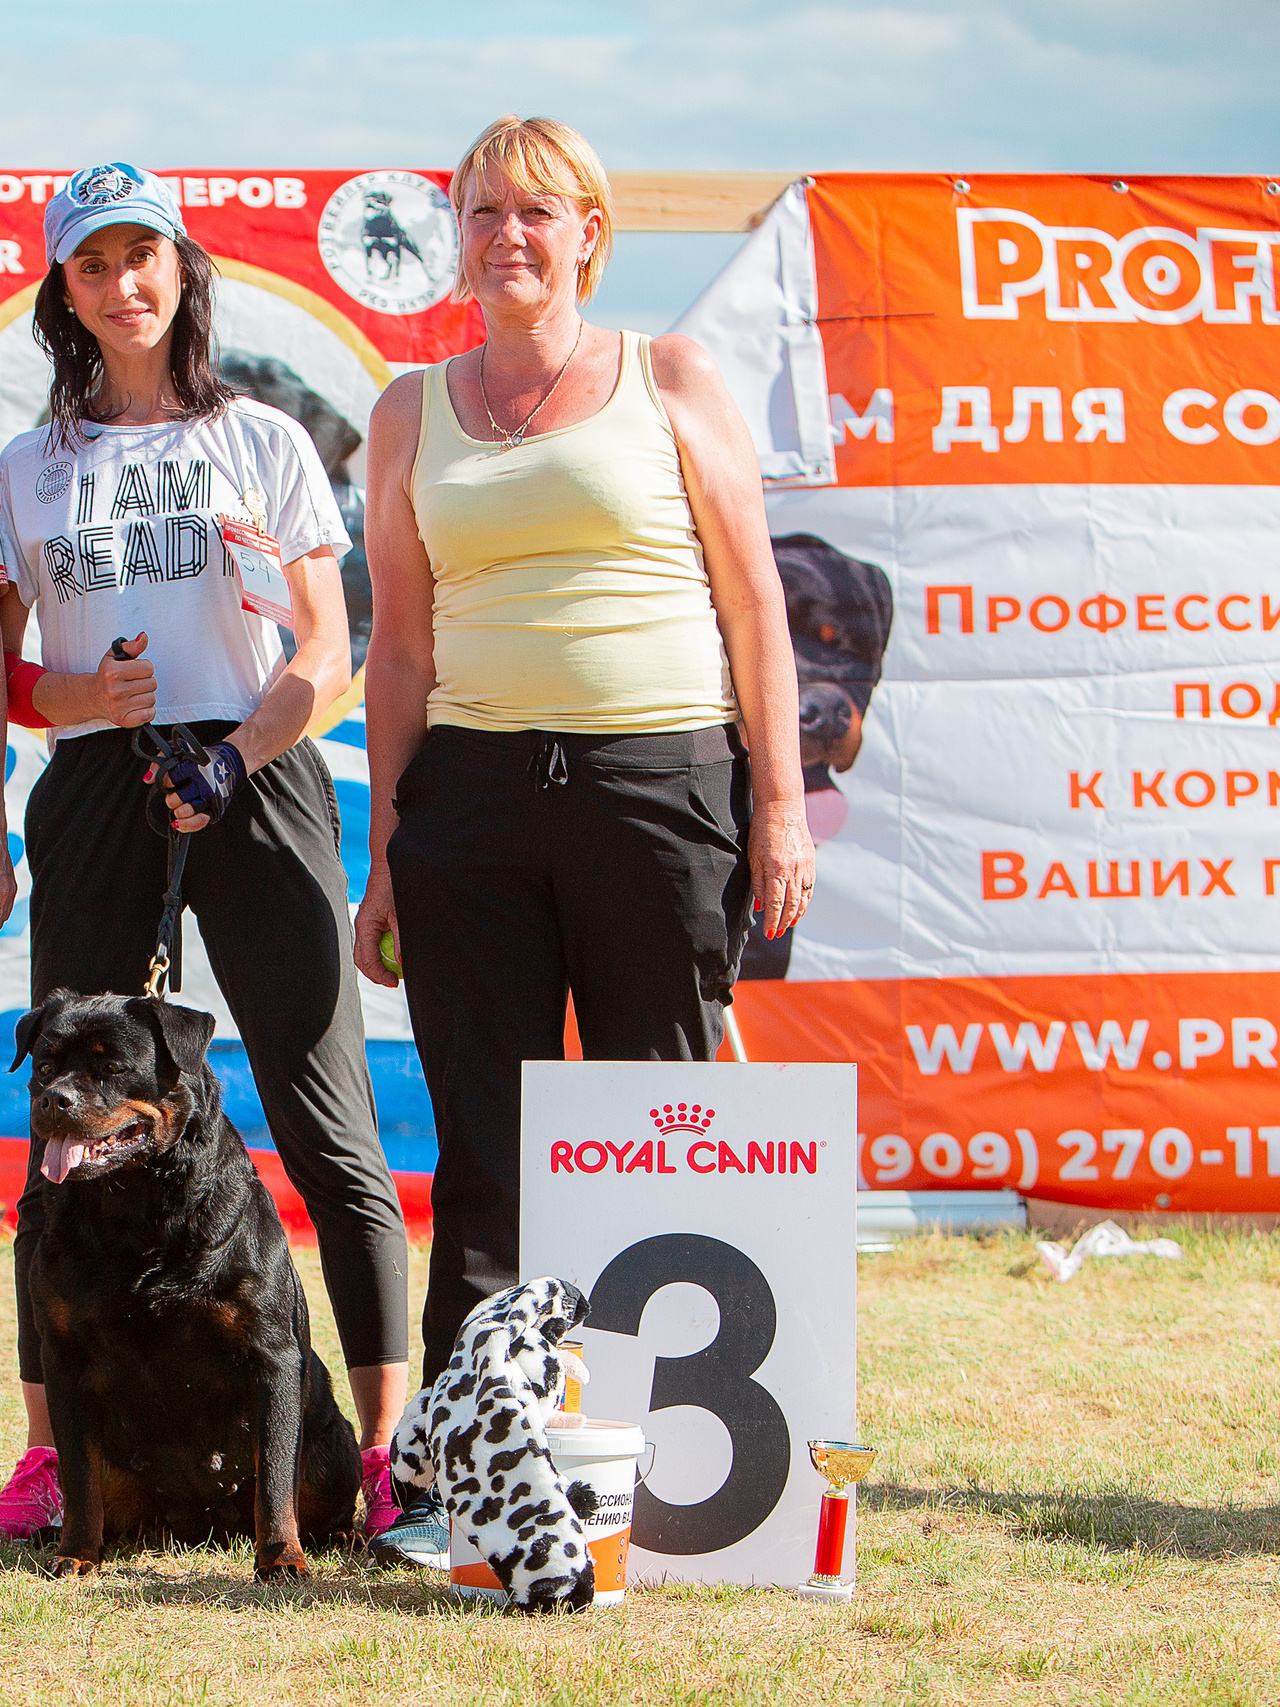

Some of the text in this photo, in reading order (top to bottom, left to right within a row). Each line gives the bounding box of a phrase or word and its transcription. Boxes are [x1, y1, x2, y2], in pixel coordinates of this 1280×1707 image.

[932, 386, 1126, 453] ДЛЯ
[77, 460, 211, 524] I AM
[1069, 771, 1106, 809] К
[980, 851, 1236, 900] ВАШИХ
[550, 1140, 818, 1175] ROYAL CANIN
[857, 1128, 1040, 1190] (909)
[582, 1233, 791, 1555] 3
